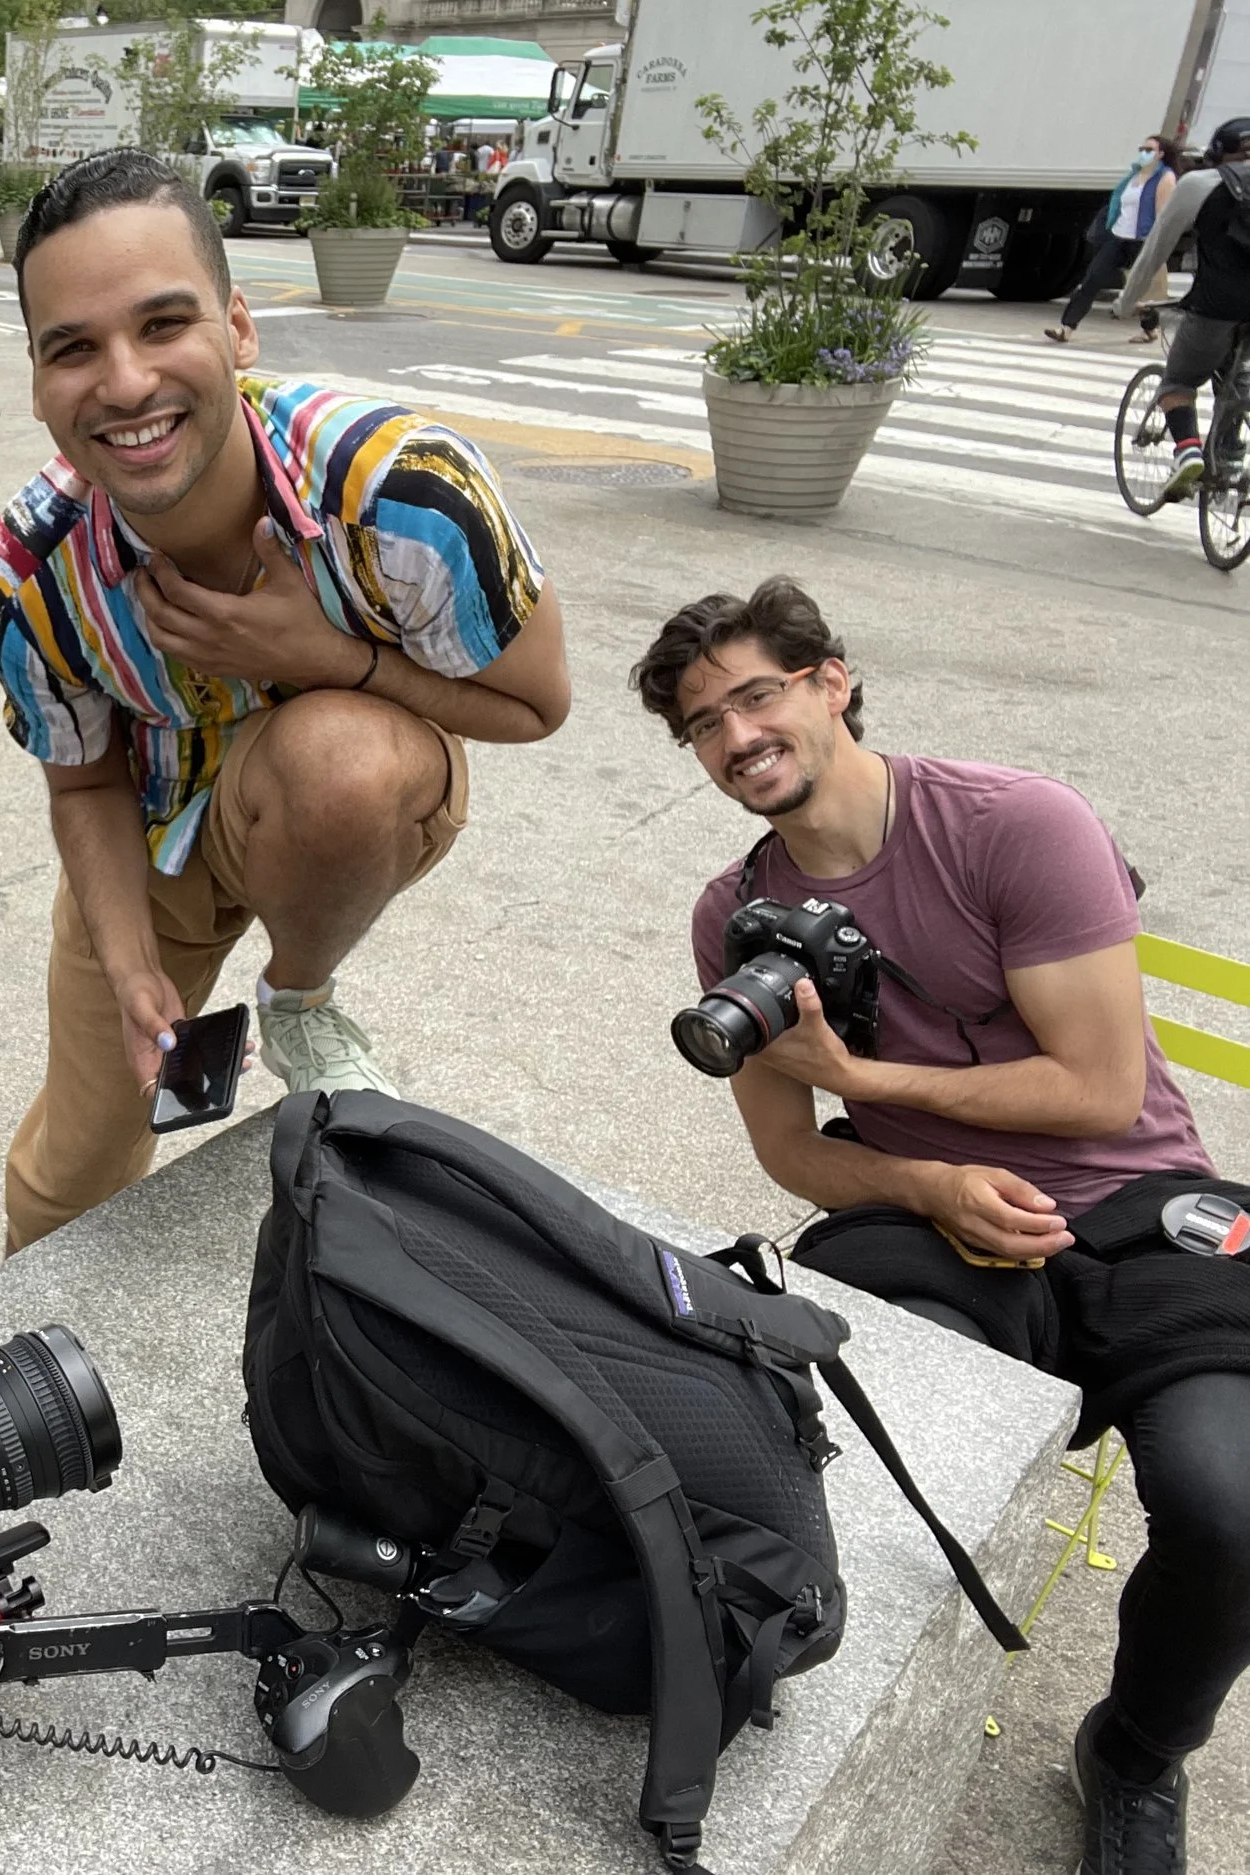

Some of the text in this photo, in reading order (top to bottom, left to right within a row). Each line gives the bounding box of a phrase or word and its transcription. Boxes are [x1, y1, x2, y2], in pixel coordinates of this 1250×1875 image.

[646, 73, 676, 83] FARMS
[776, 933, 803, 949] Canon
[29, 1642, 91, 1660] SONY
[302, 1681, 330, 1709] SONY
